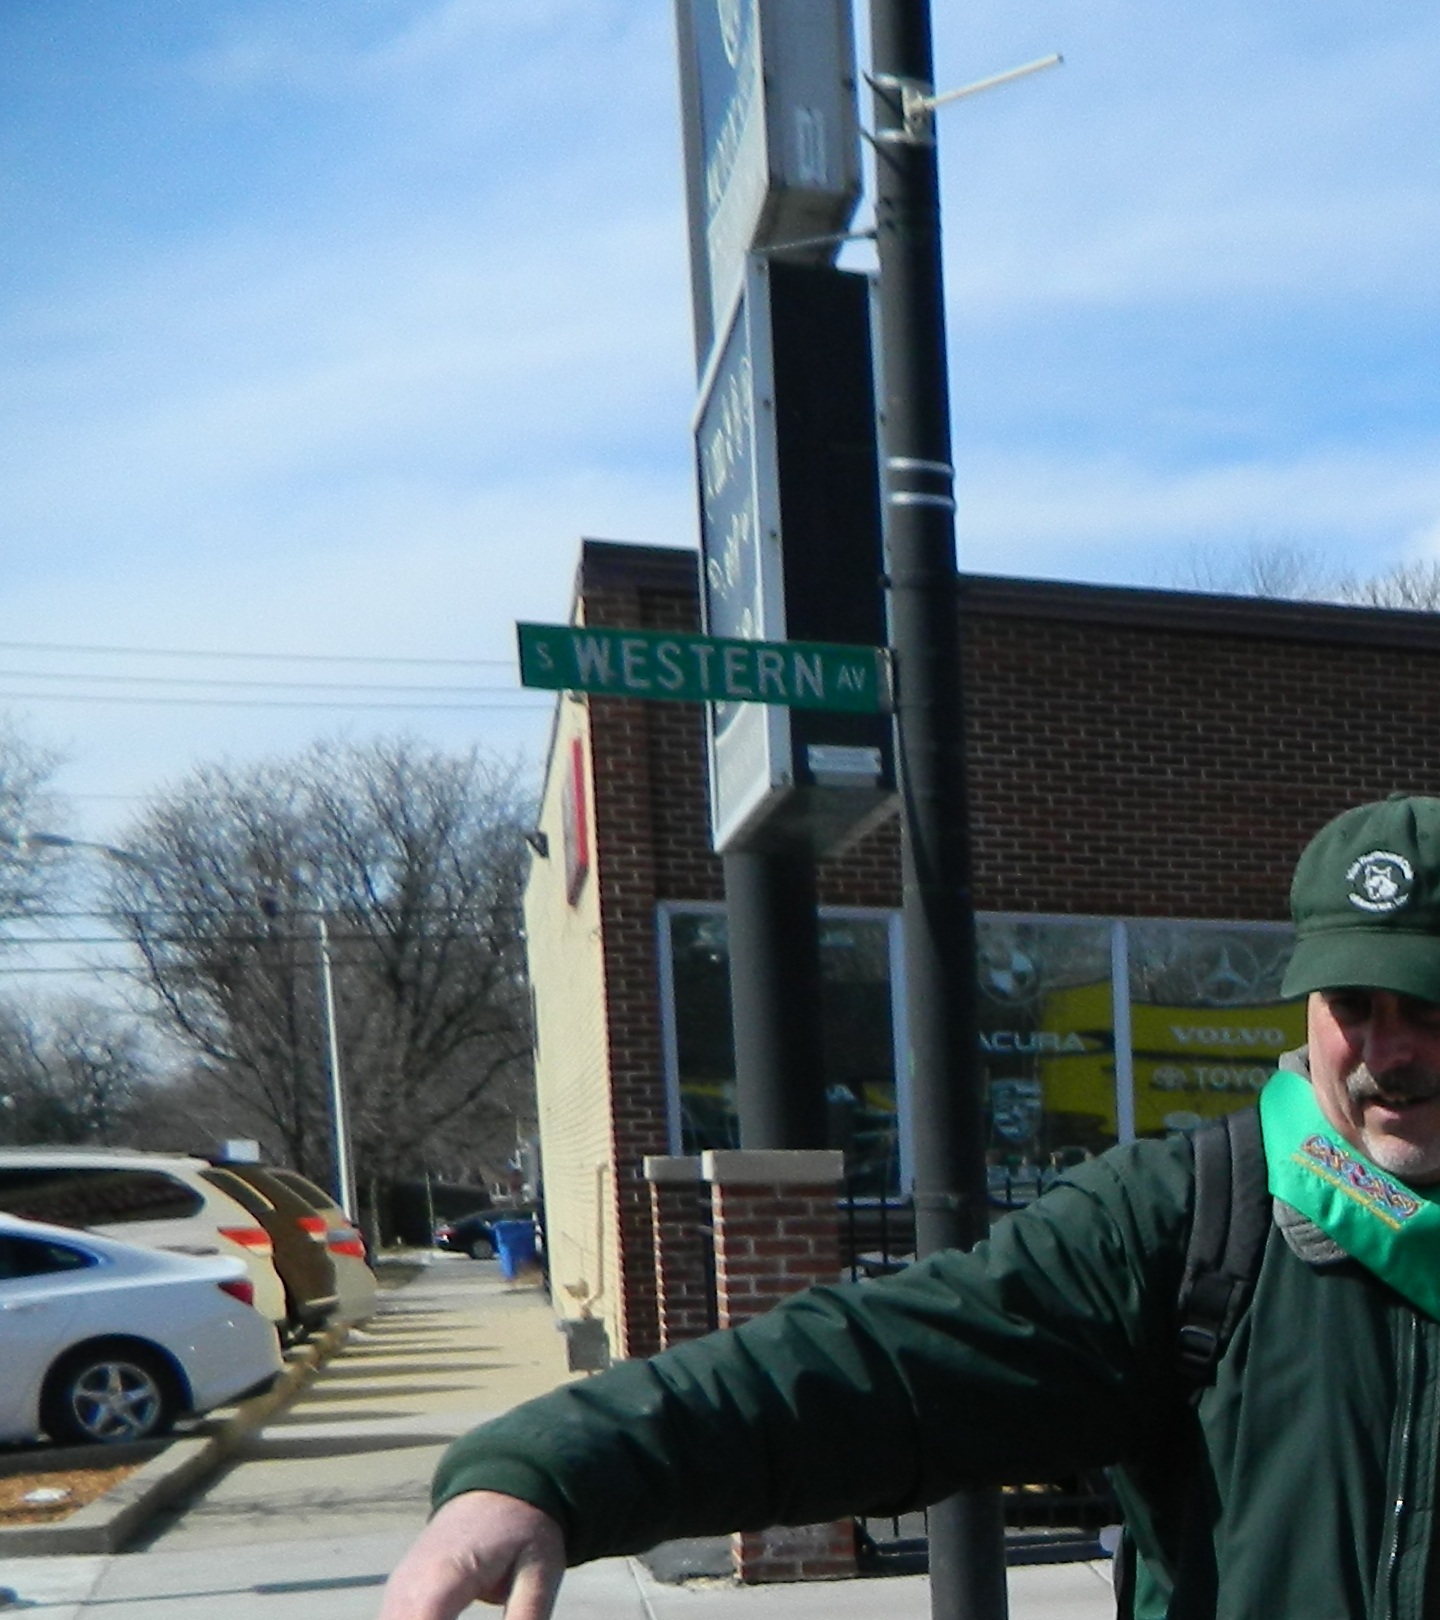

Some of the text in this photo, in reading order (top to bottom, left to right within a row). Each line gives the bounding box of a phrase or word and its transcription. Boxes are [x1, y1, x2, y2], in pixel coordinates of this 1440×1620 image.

[535, 633, 866, 700] S WESTERN AV
[1168, 1026, 1287, 1047] VOLVO
[1193, 1066, 1269, 1092] TOYO
